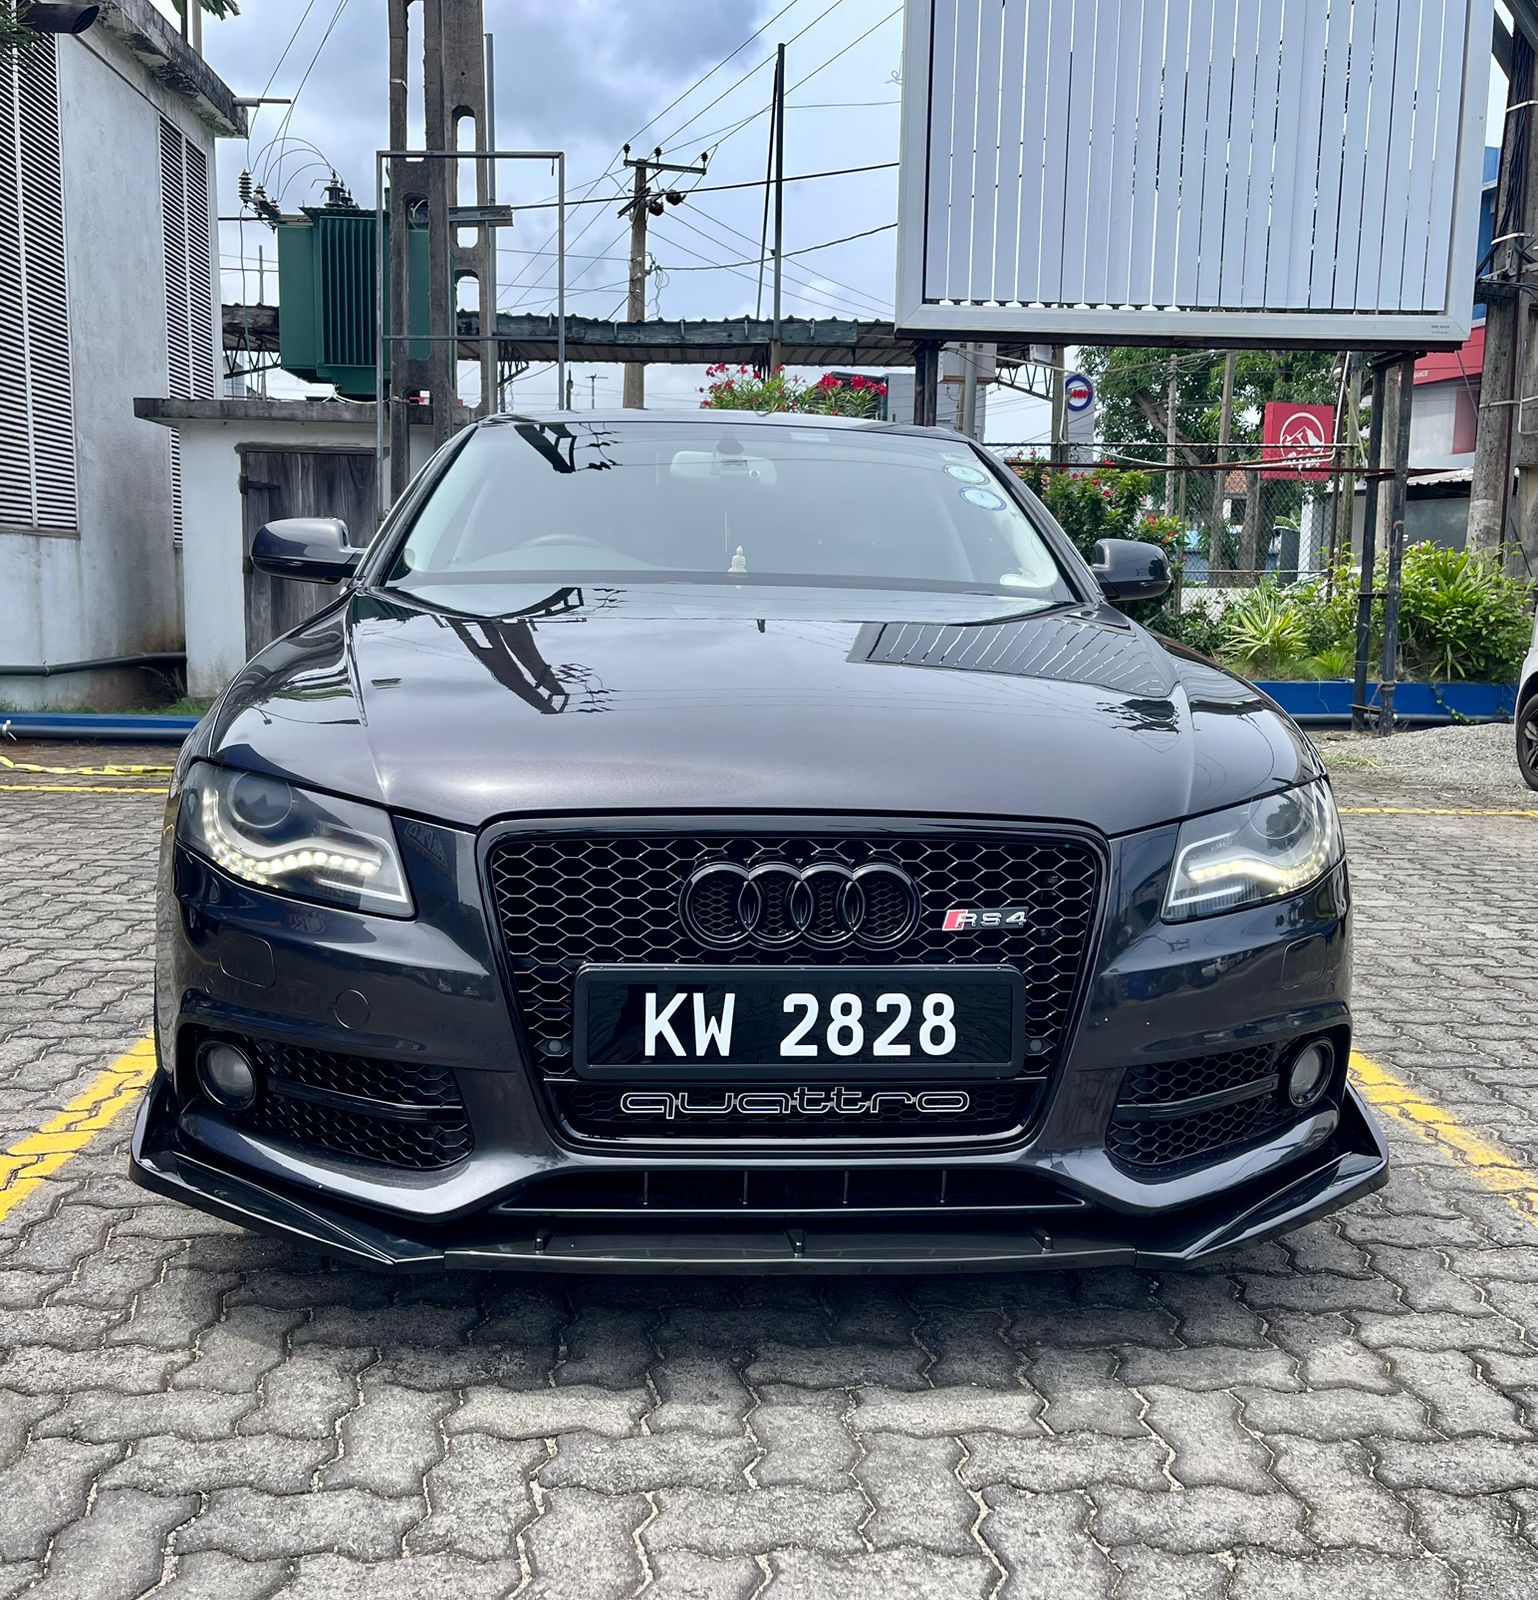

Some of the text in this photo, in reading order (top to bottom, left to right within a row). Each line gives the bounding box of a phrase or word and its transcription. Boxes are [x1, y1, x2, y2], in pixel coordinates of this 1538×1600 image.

[955, 911, 1027, 929] RS4
[644, 992, 957, 1057] KW 2828
[620, 1086, 970, 1120] quattro
